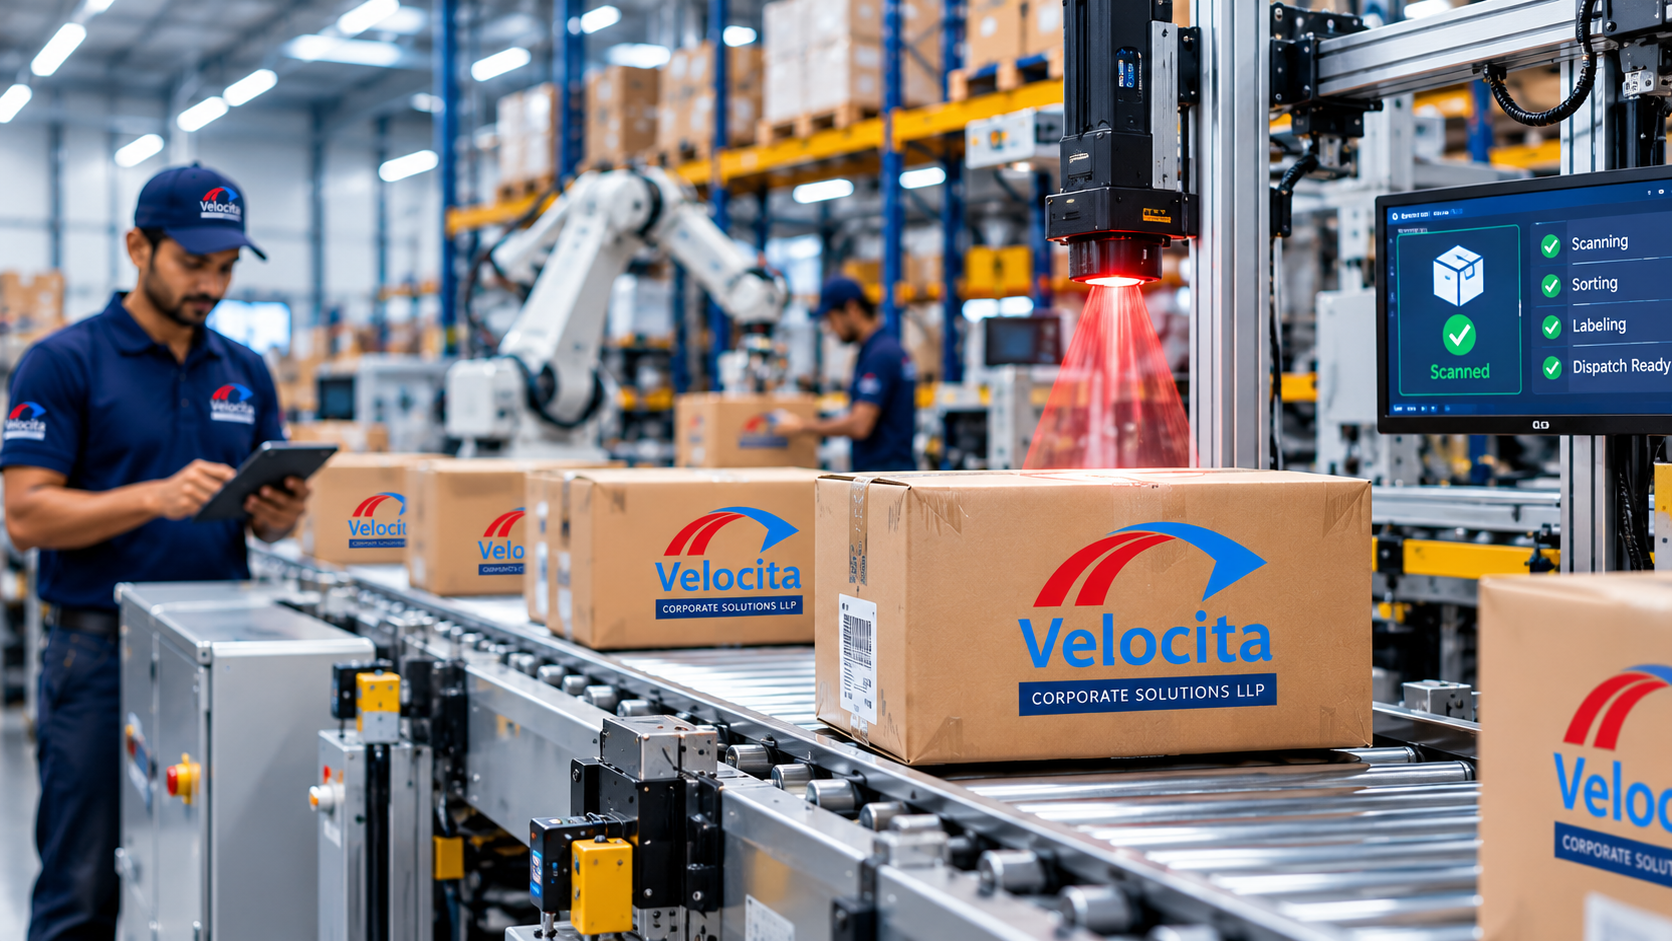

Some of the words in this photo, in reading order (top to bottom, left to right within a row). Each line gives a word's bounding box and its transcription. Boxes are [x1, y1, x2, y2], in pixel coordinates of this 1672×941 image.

[199, 200, 241, 214] Velocita
[1572, 234, 1629, 251] Scanning
[1573, 276, 1618, 292] Sorting
[1573, 317, 1627, 334] Labeling
[1430, 362, 1490, 380] Scanned
[1573, 358, 1628, 376] Dispatch
[1631, 357, 1672, 375] Ready
[478, 540, 525, 560] Velo
[655, 558, 802, 592] Velocita
[662, 603, 719, 613] CORPORATE
[722, 601, 776, 612] SOLUTIONS
[780, 601, 797, 610] LLP
[1018, 609, 1273, 669] Velocita
[1032, 688, 1129, 705] CORPORATE
[1136, 684, 1230, 702] SOLUTIONS
[1236, 683, 1265, 698] LLP
[1562, 834, 1632, 866] CORPORATE
